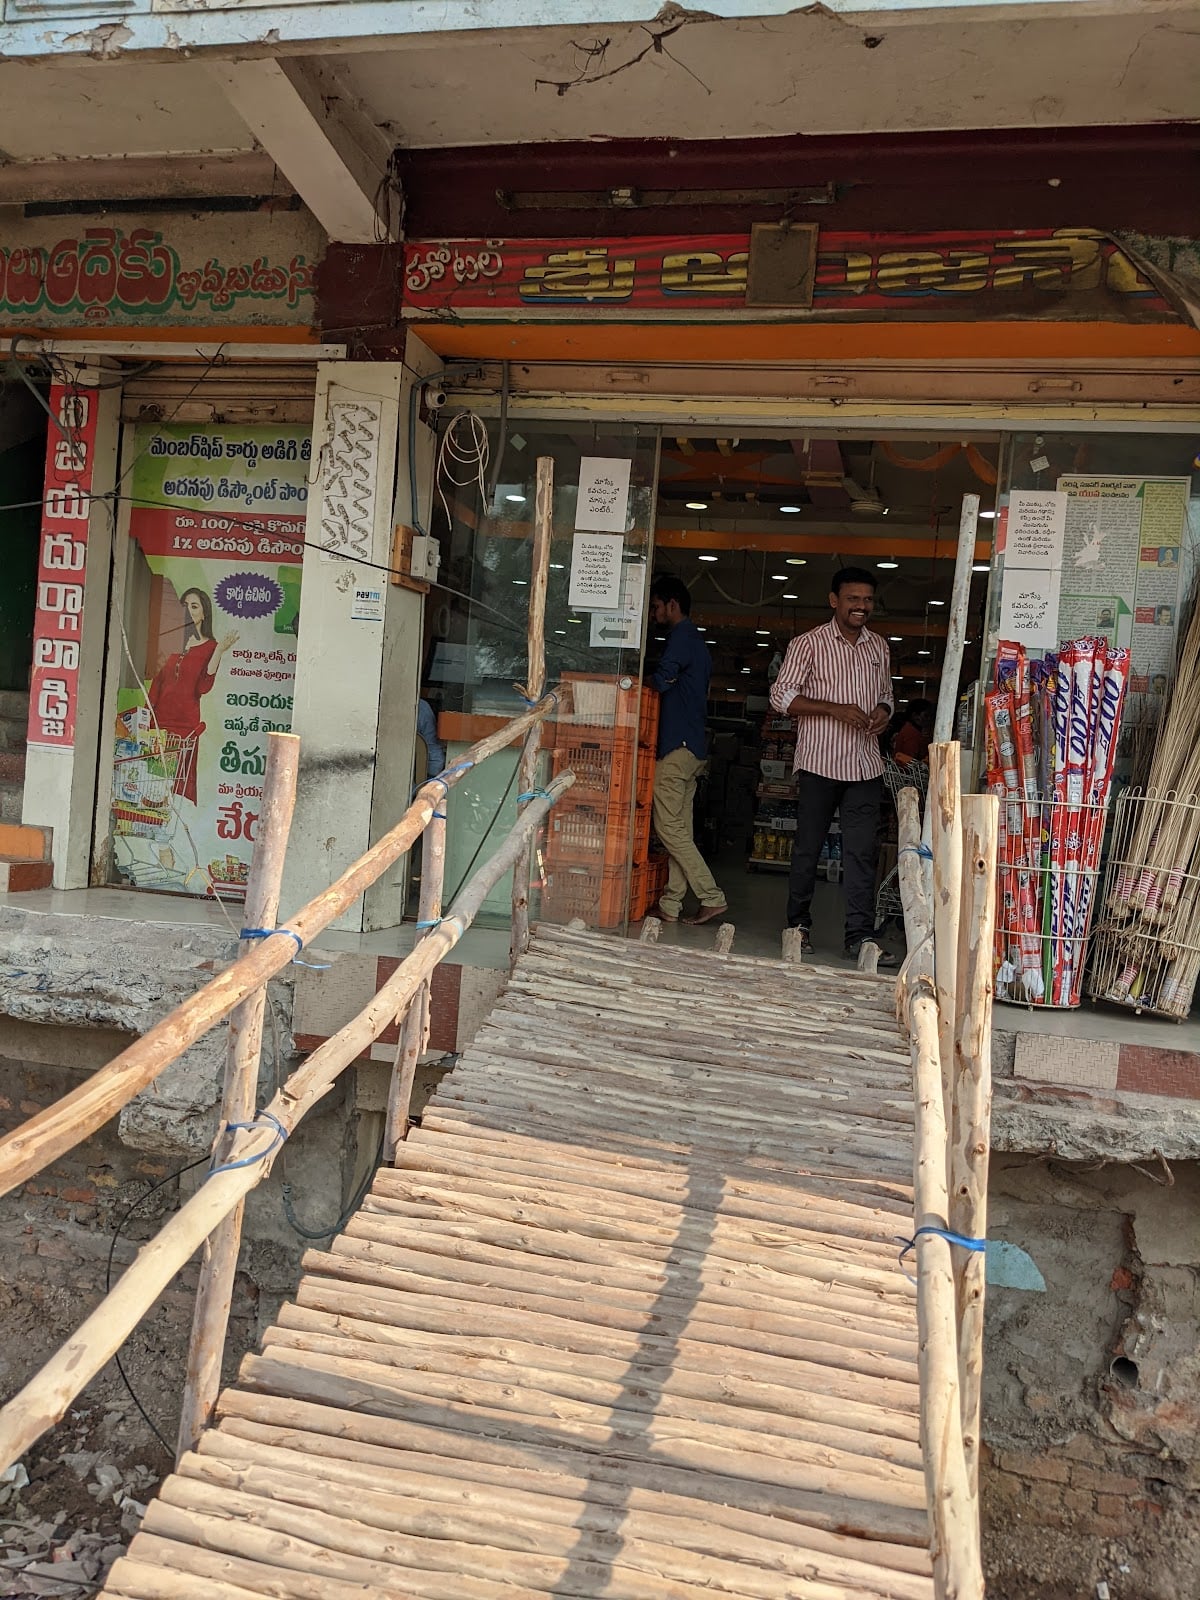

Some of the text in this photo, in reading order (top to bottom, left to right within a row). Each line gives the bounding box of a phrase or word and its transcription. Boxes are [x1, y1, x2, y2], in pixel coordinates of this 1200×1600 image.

[226, 440, 258, 468] కార్డు
[261, 440, 297, 460] అడిగి
[164, 477, 214, 501] అదనపు
[196, 537, 254, 556] అదనపు
